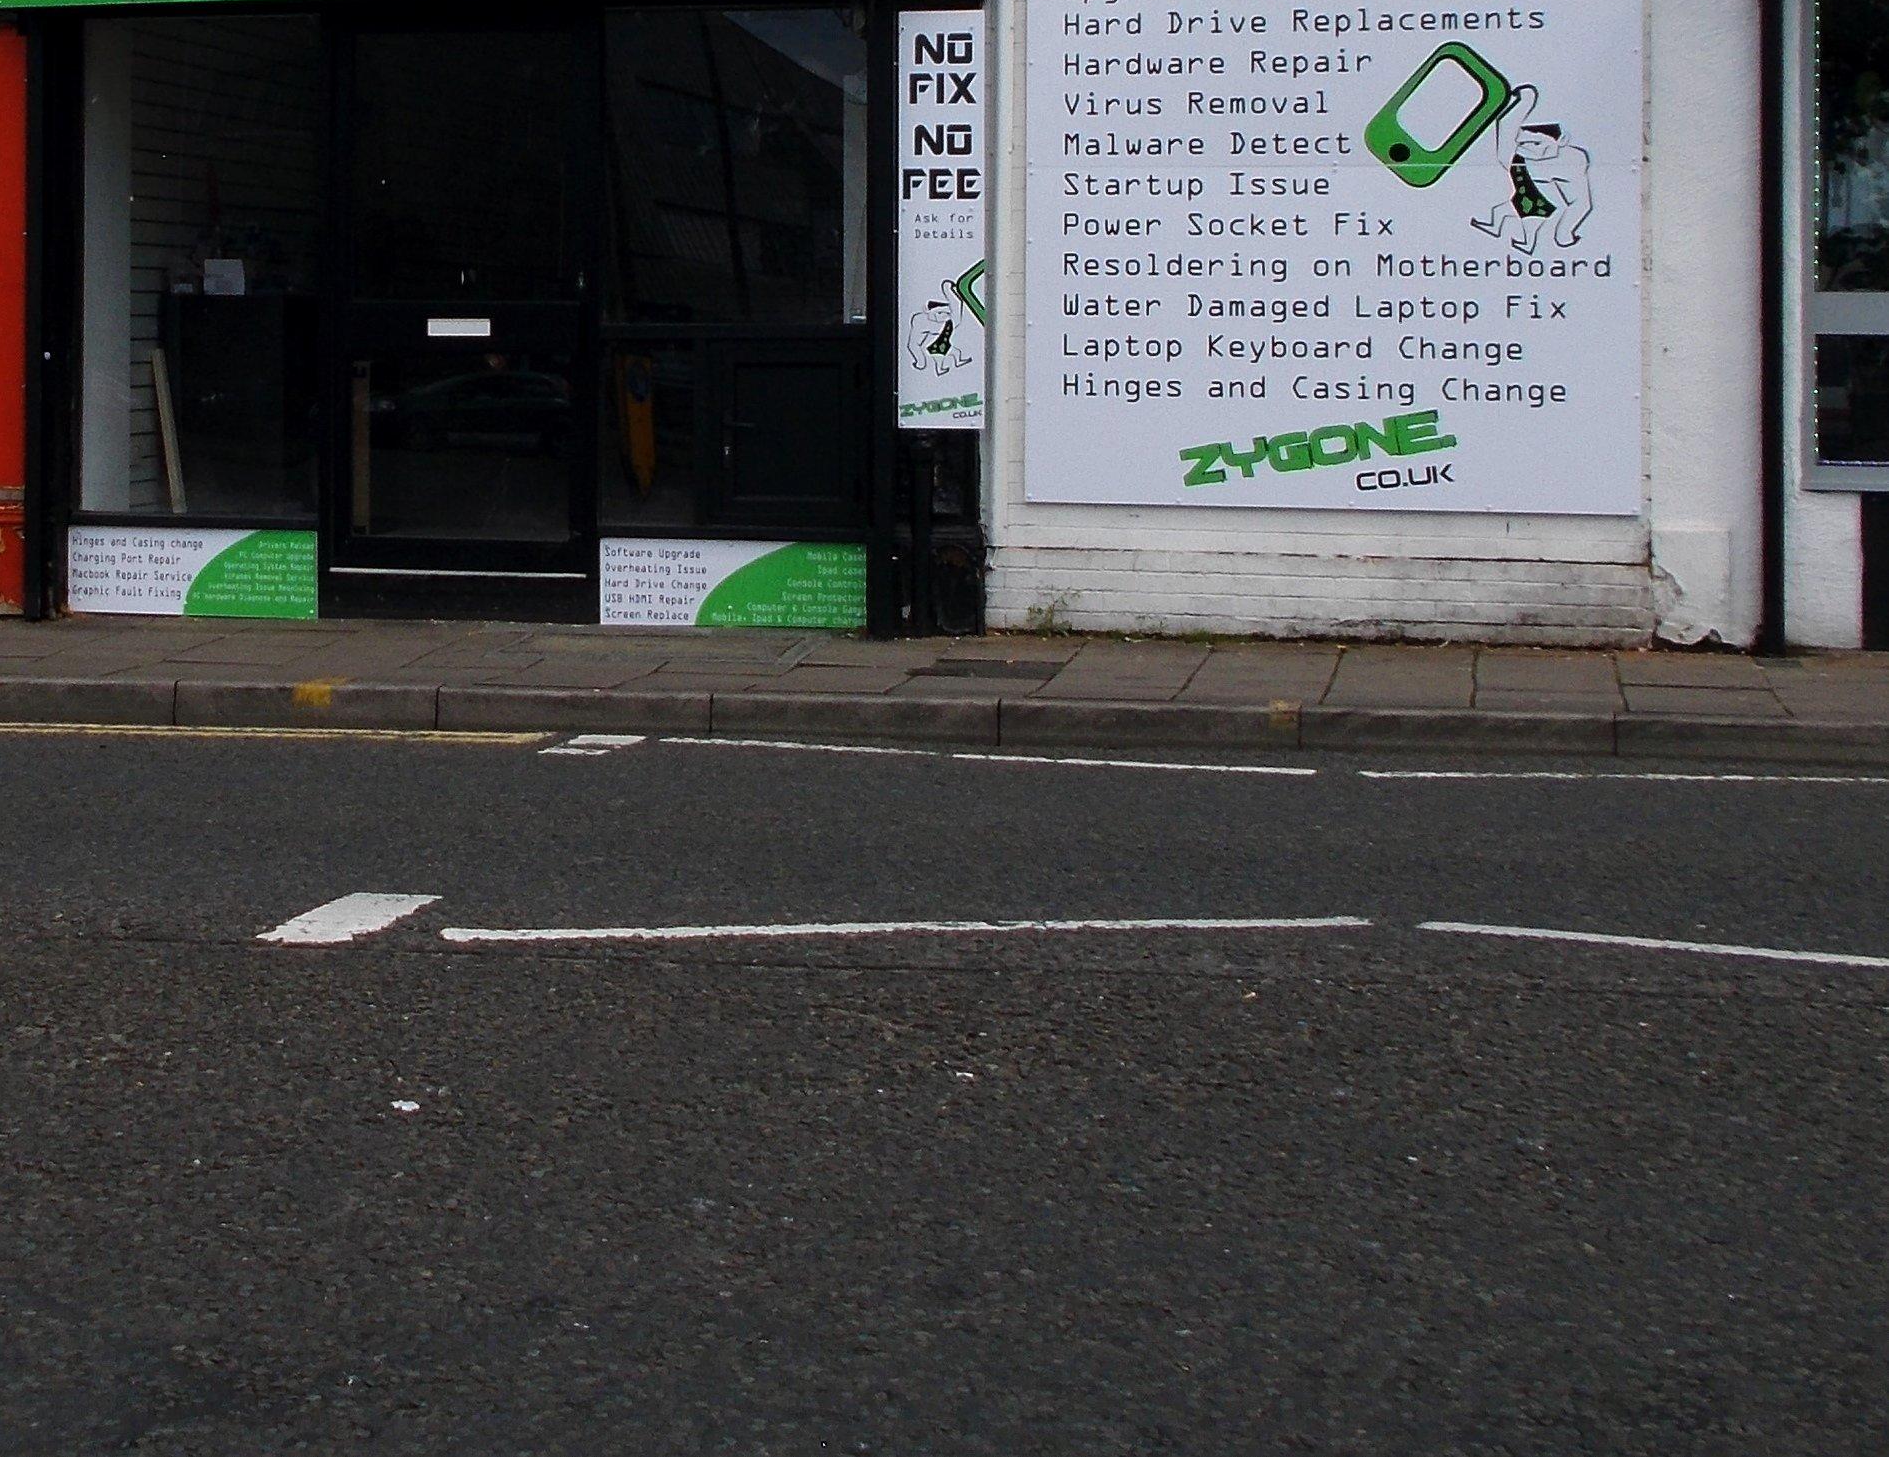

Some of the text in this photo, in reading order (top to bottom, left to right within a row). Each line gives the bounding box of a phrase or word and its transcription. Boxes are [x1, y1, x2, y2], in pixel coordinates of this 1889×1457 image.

[1064, 7, 1545, 37] Hard Drive Replacements
[914, 32, 973, 65] NO
[1064, 48, 1371, 78] Hardware Repair
[909, 73, 977, 105] FIX
[1064, 90, 1328, 116] Virus Removal
[913, 123, 972, 156] NO
[1064, 131, 1351, 156] Malware Detect
[902, 168, 982, 200] FEE
[1064, 172, 1330, 201] Startup Issue
[914, 212, 973, 224] Ask for
[1064, 211, 1394, 236] Power Socket Fix
[914, 228, 974, 240] Details
[1064, 252, 1611, 282] Resoldering on Motherboard
[1064, 293, 1567, 323] Water Damaged Laptop Fix
[1064, 334, 1522, 366] Laptop Keyboard Change
[1064, 373, 1567, 407] Hinges and Casing Change
[1356, 463, 1456, 490] CO.UK
[72, 536, 203, 551] Hinges and Casing change
[605, 545, 700, 560] Software Upgrade
[73, 552, 181, 565] Charging Port Repair
[605, 562, 707, 575] Overheating Issue
[116, 570, 148, 580] Repair
[154, 571, 192, 582] Service
[605, 578, 707, 591] Hard Drive Change
[72, 585, 109, 595] Graphic
[116, 586, 142, 597] Fault
[149, 587, 181, 600] Fixing
[605, 593, 695, 606] USB HDMI Repair
[605, 608, 689, 620] Screen Replace
